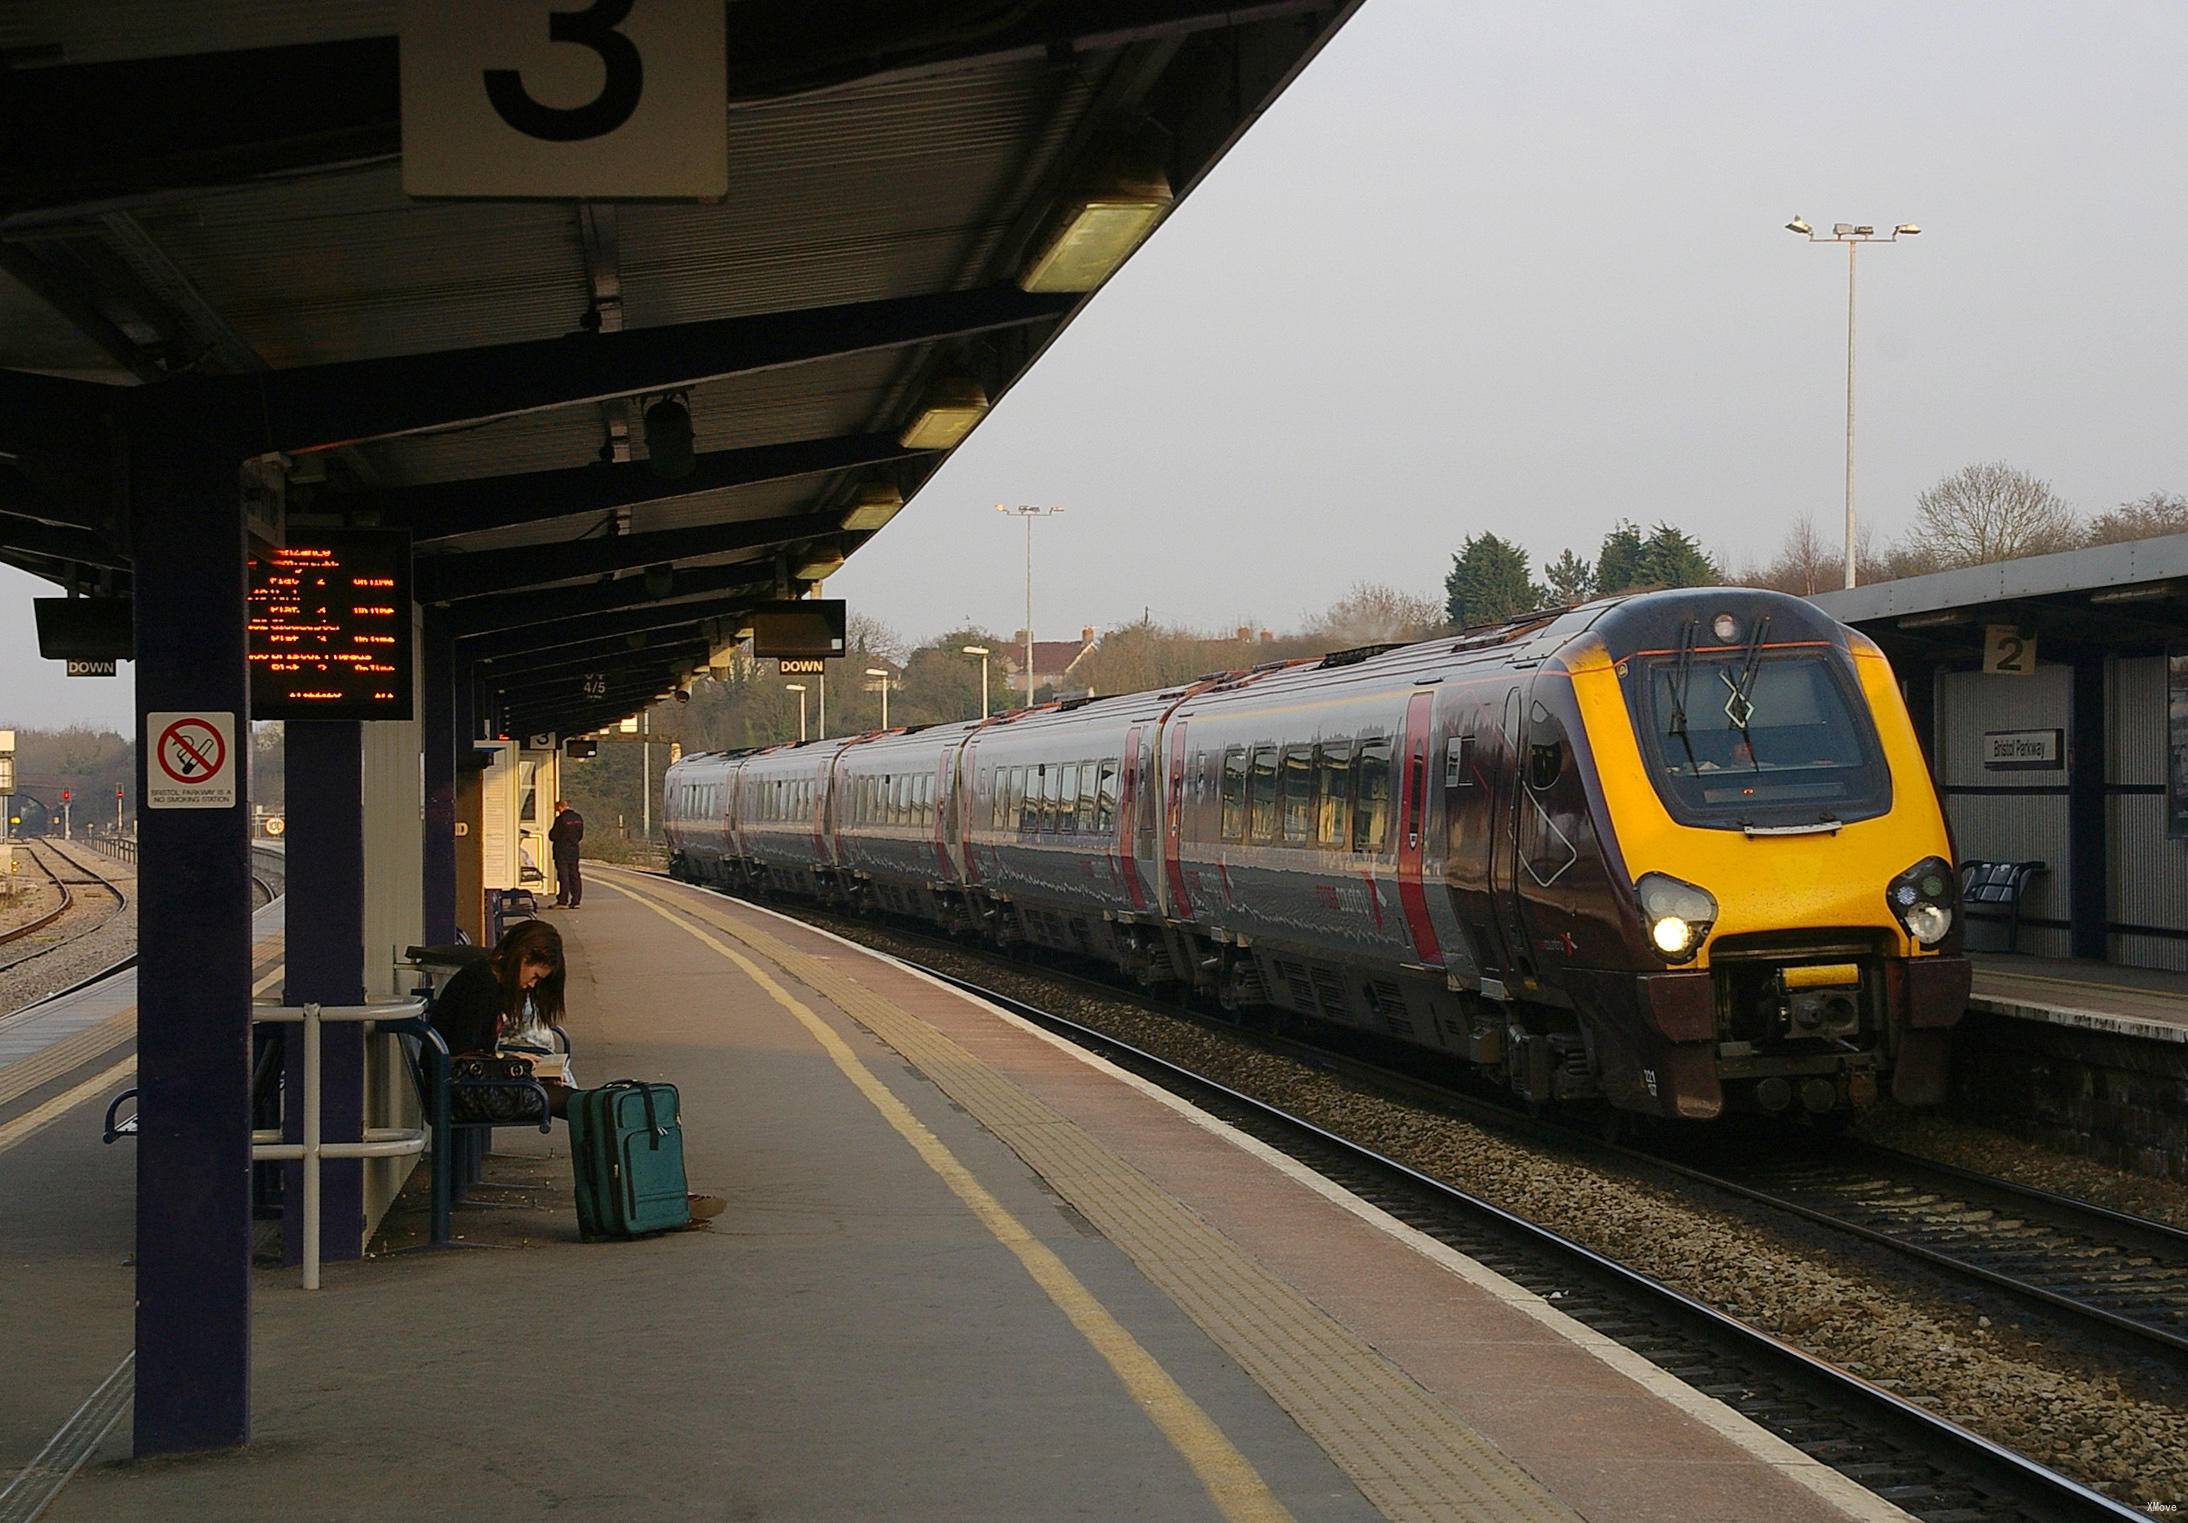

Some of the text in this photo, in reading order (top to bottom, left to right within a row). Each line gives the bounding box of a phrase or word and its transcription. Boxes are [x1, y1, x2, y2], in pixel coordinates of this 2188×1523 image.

[483, 0, 644, 142] 3
[1996, 636, 2024, 672] 2
[68, 661, 114, 674] DOWN
[780, 660, 824, 673] DOWN
[1993, 738, 2046, 759] Bristol Parkway
